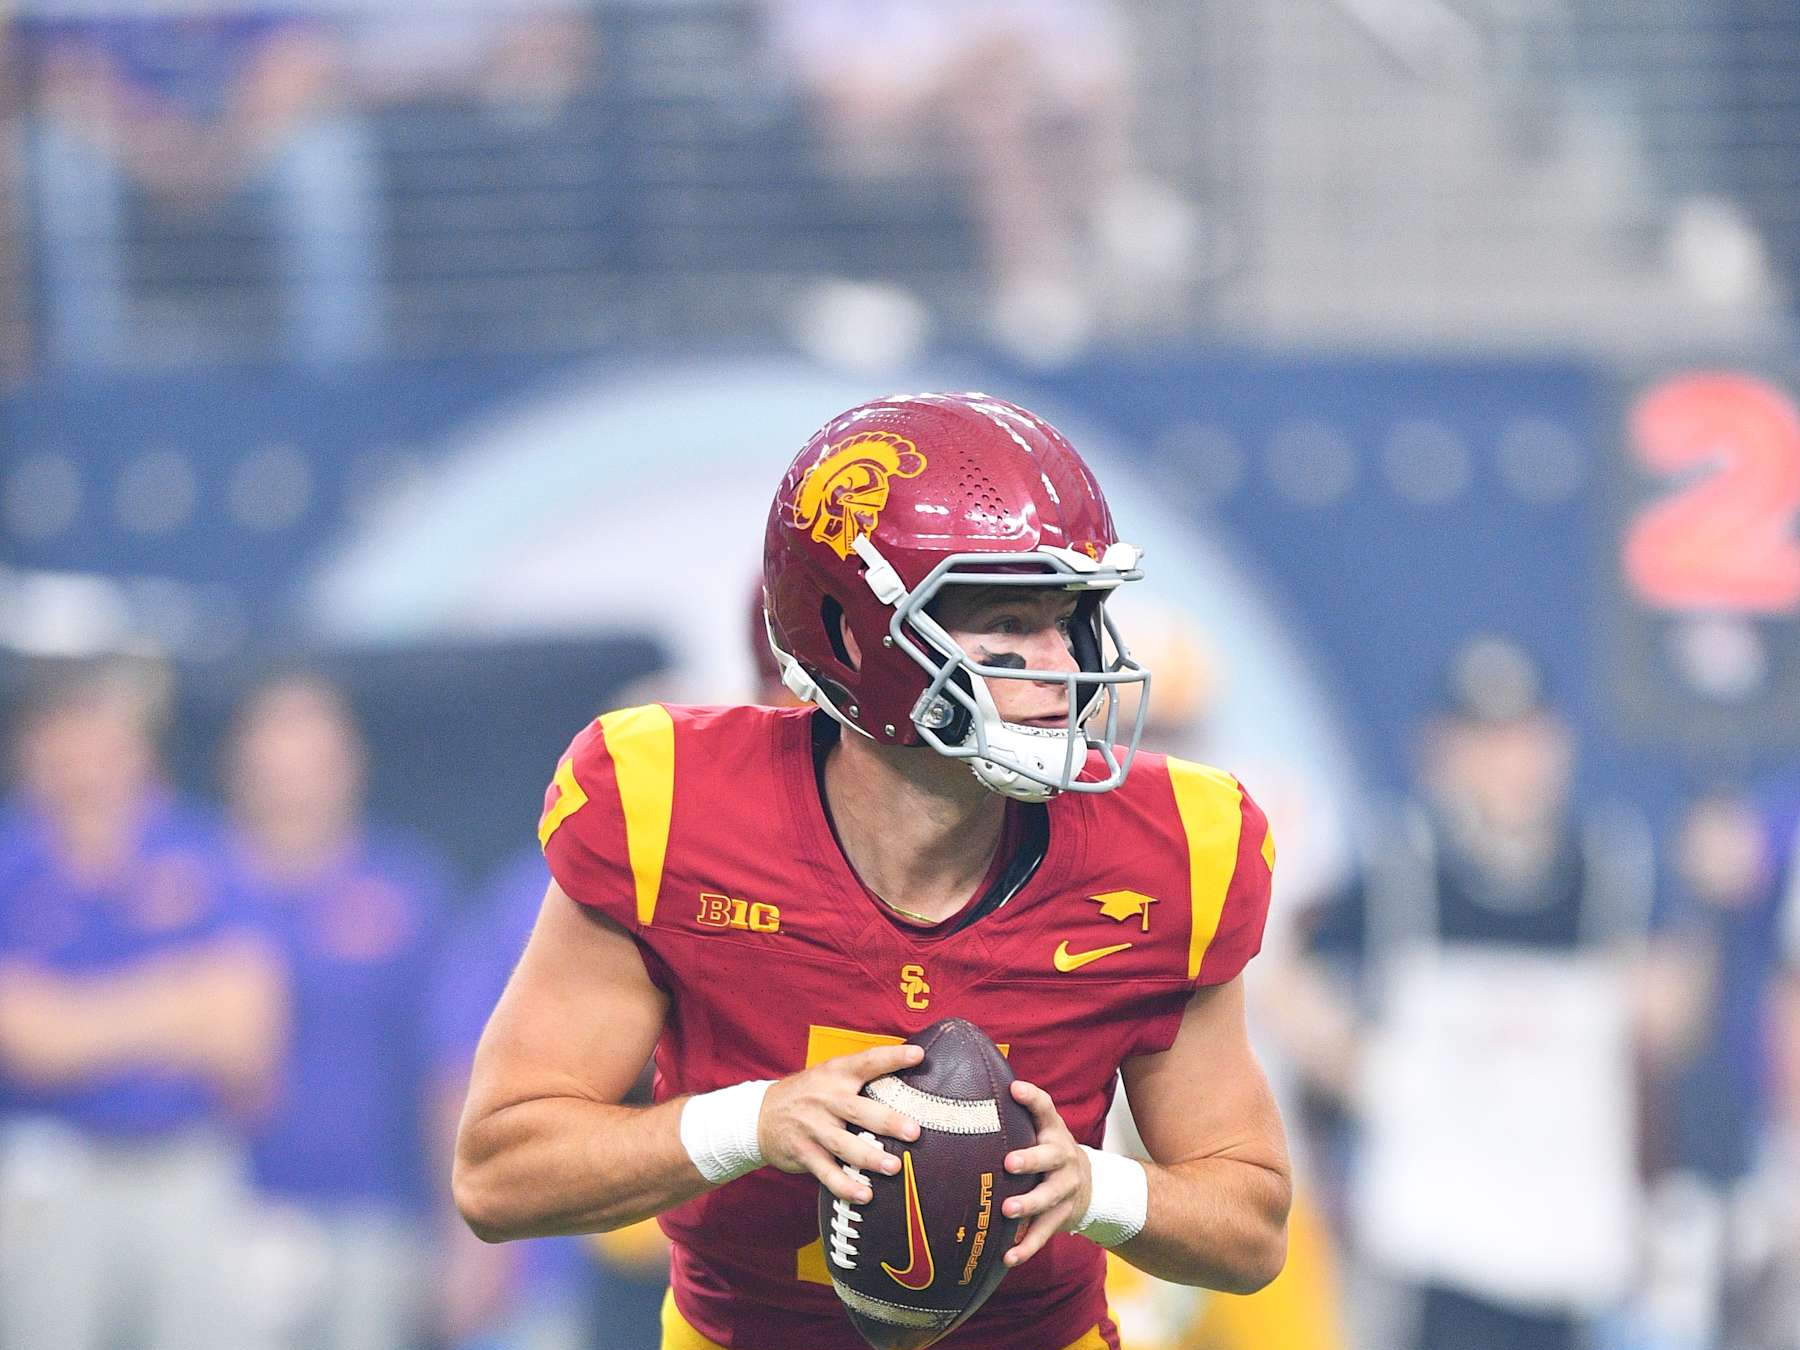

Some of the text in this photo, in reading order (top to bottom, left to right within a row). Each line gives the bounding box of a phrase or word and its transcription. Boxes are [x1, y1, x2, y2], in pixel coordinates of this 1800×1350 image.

[1623, 372, 1800, 611] 2
[958, 1229, 987, 1285] VAPOR
[977, 1172, 993, 1230] ELITE
